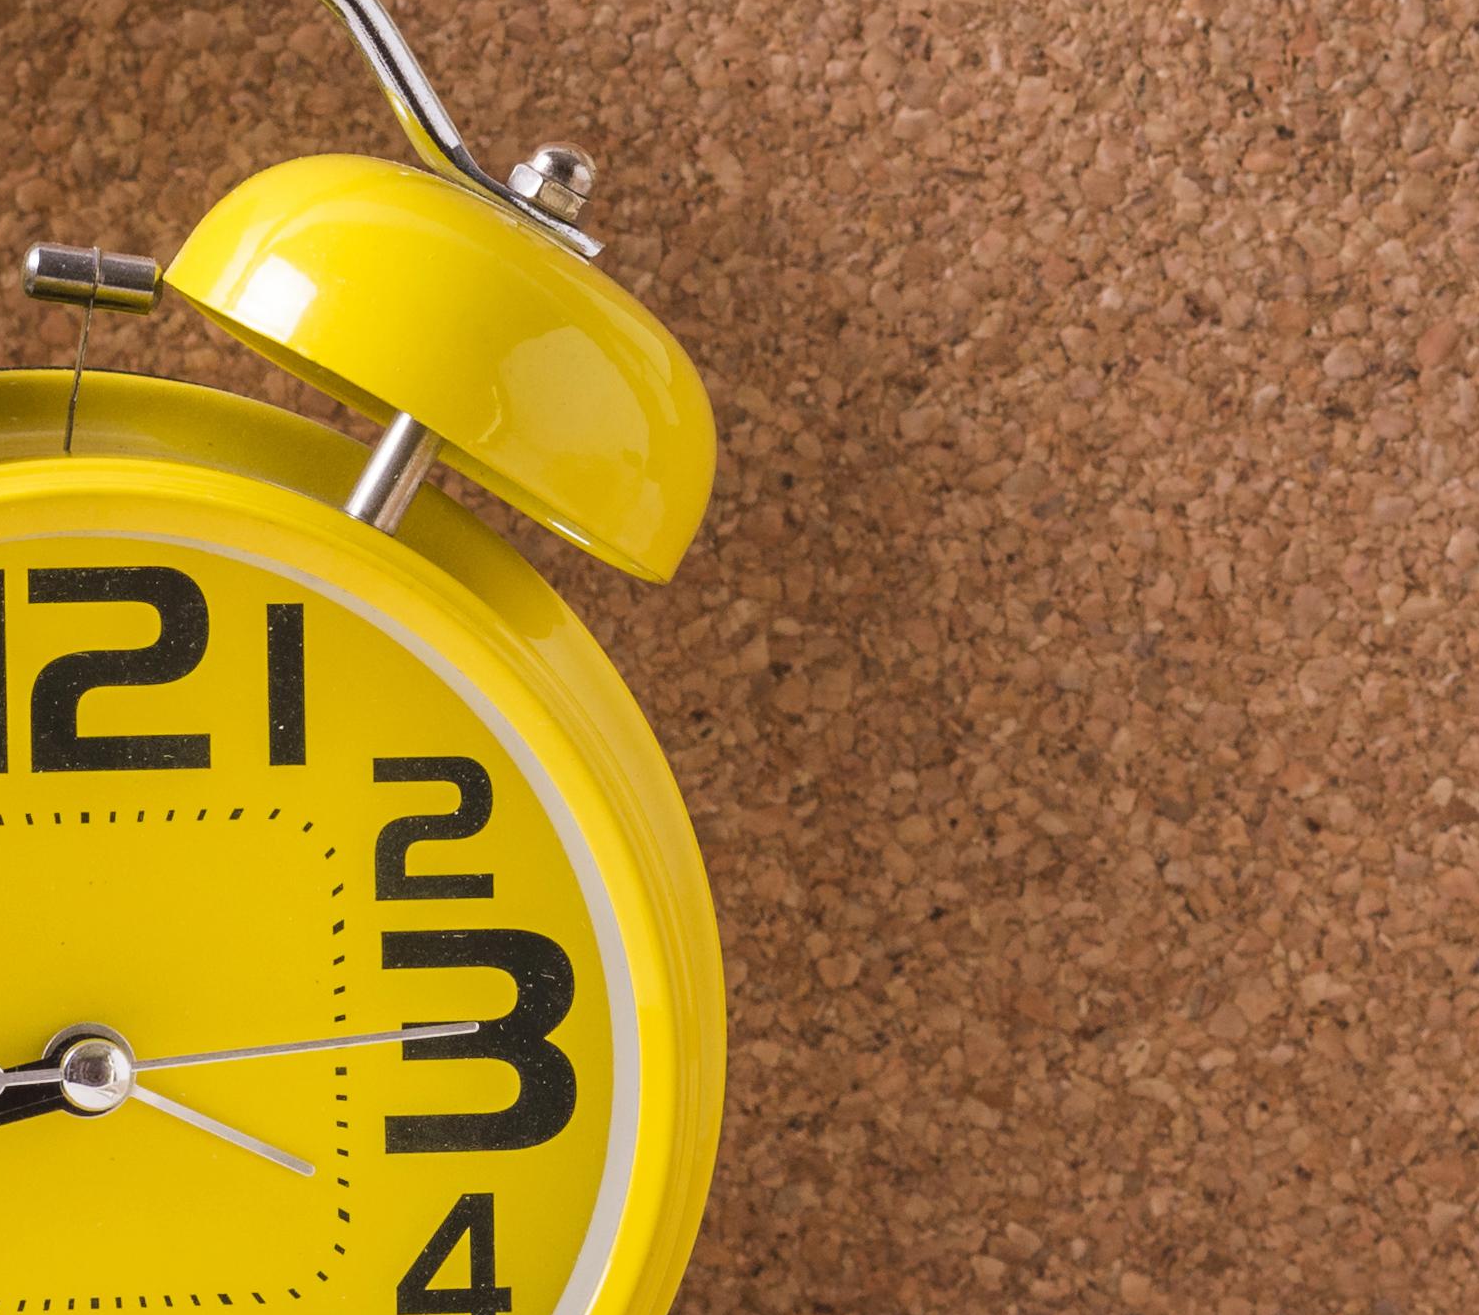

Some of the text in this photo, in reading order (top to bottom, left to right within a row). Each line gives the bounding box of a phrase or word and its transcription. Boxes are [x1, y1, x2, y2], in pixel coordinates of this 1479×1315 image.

[266, 602, 306, 766] 1
[373, 755, 495, 901] 2
[381, 928, 578, 1154] 3
